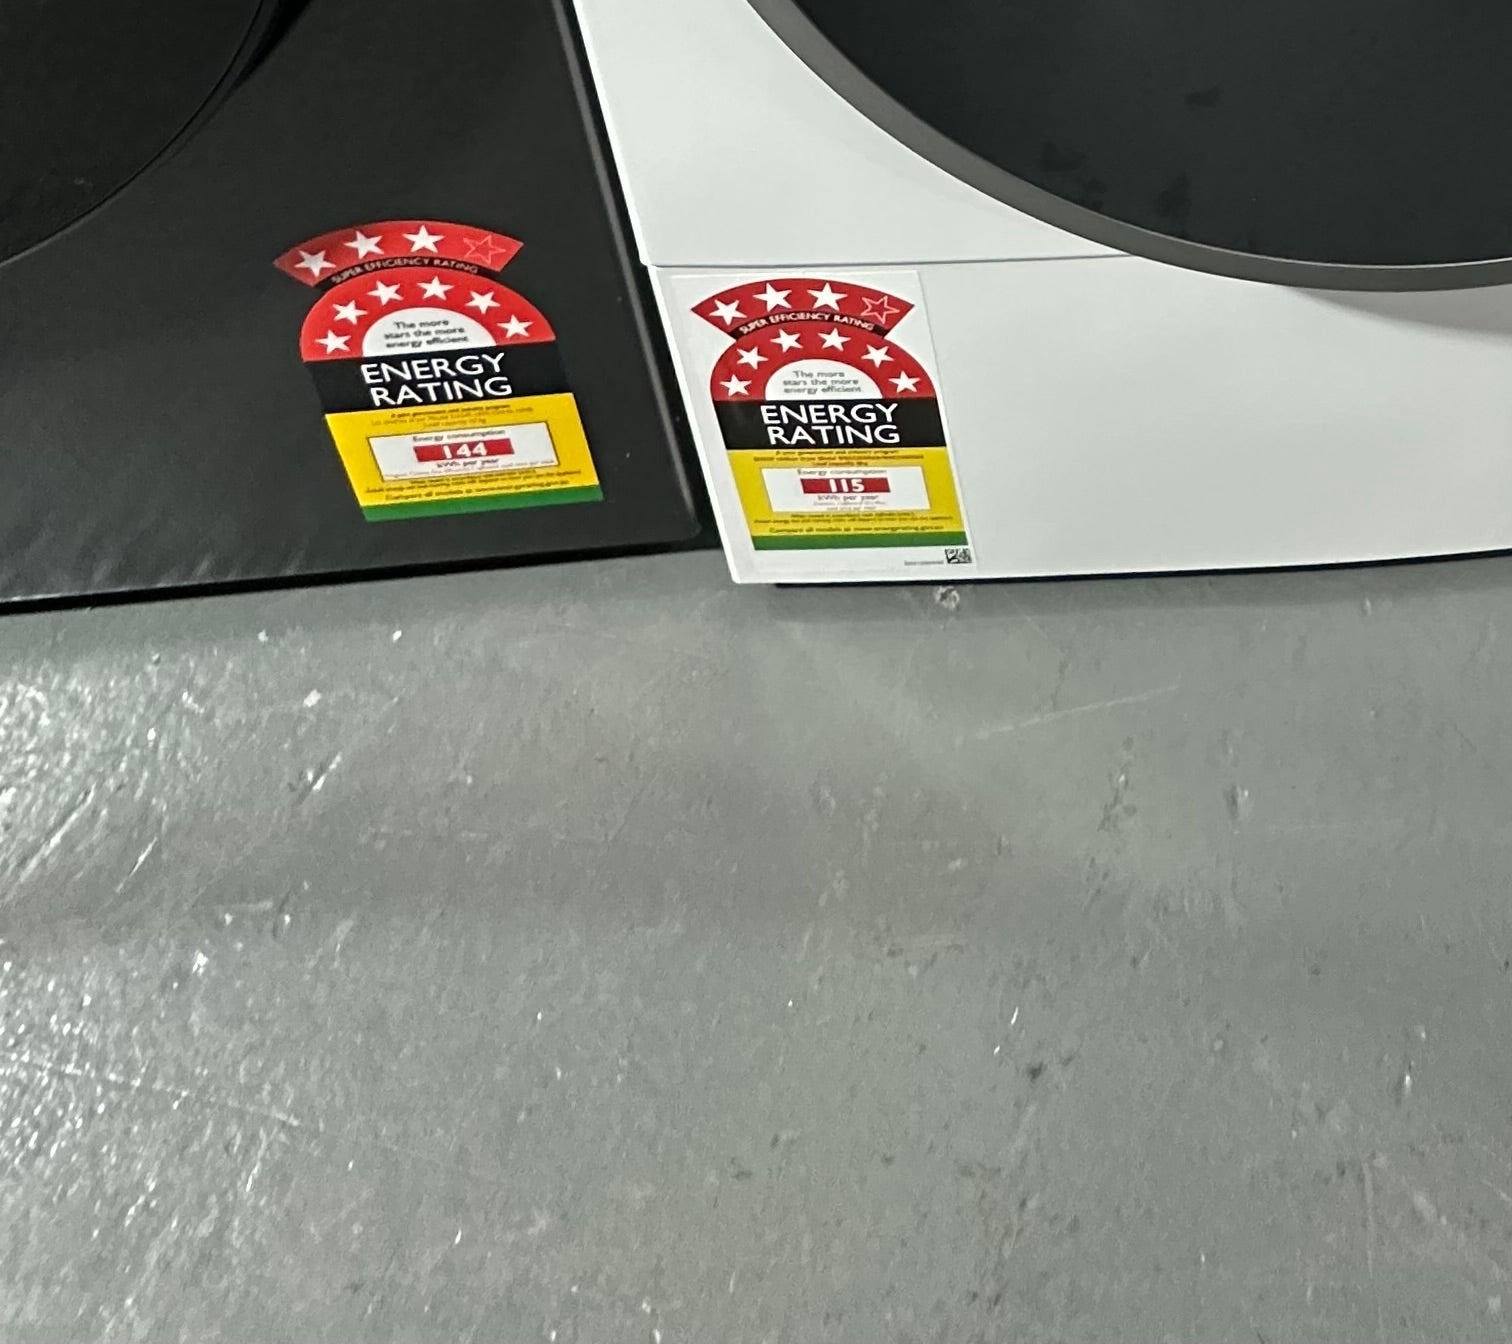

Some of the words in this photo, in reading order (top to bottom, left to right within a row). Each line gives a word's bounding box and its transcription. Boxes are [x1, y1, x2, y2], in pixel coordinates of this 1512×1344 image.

[332, 267, 363, 284] SUPER
[364, 257, 430, 273] EFFICIENCY
[433, 258, 479, 275] RATING
[738, 319, 769, 335] SUPER
[769, 311, 831, 324] EFFICIENCY
[833, 315, 876, 332] RATING
[360, 352, 505, 385] ENERGY
[370, 376, 513, 407] RATING
[760, 403, 899, 424] ENERGY
[767, 424, 900, 445] RATING
[442, 442, 488, 459] 144
[828, 478, 865, 492] 115
